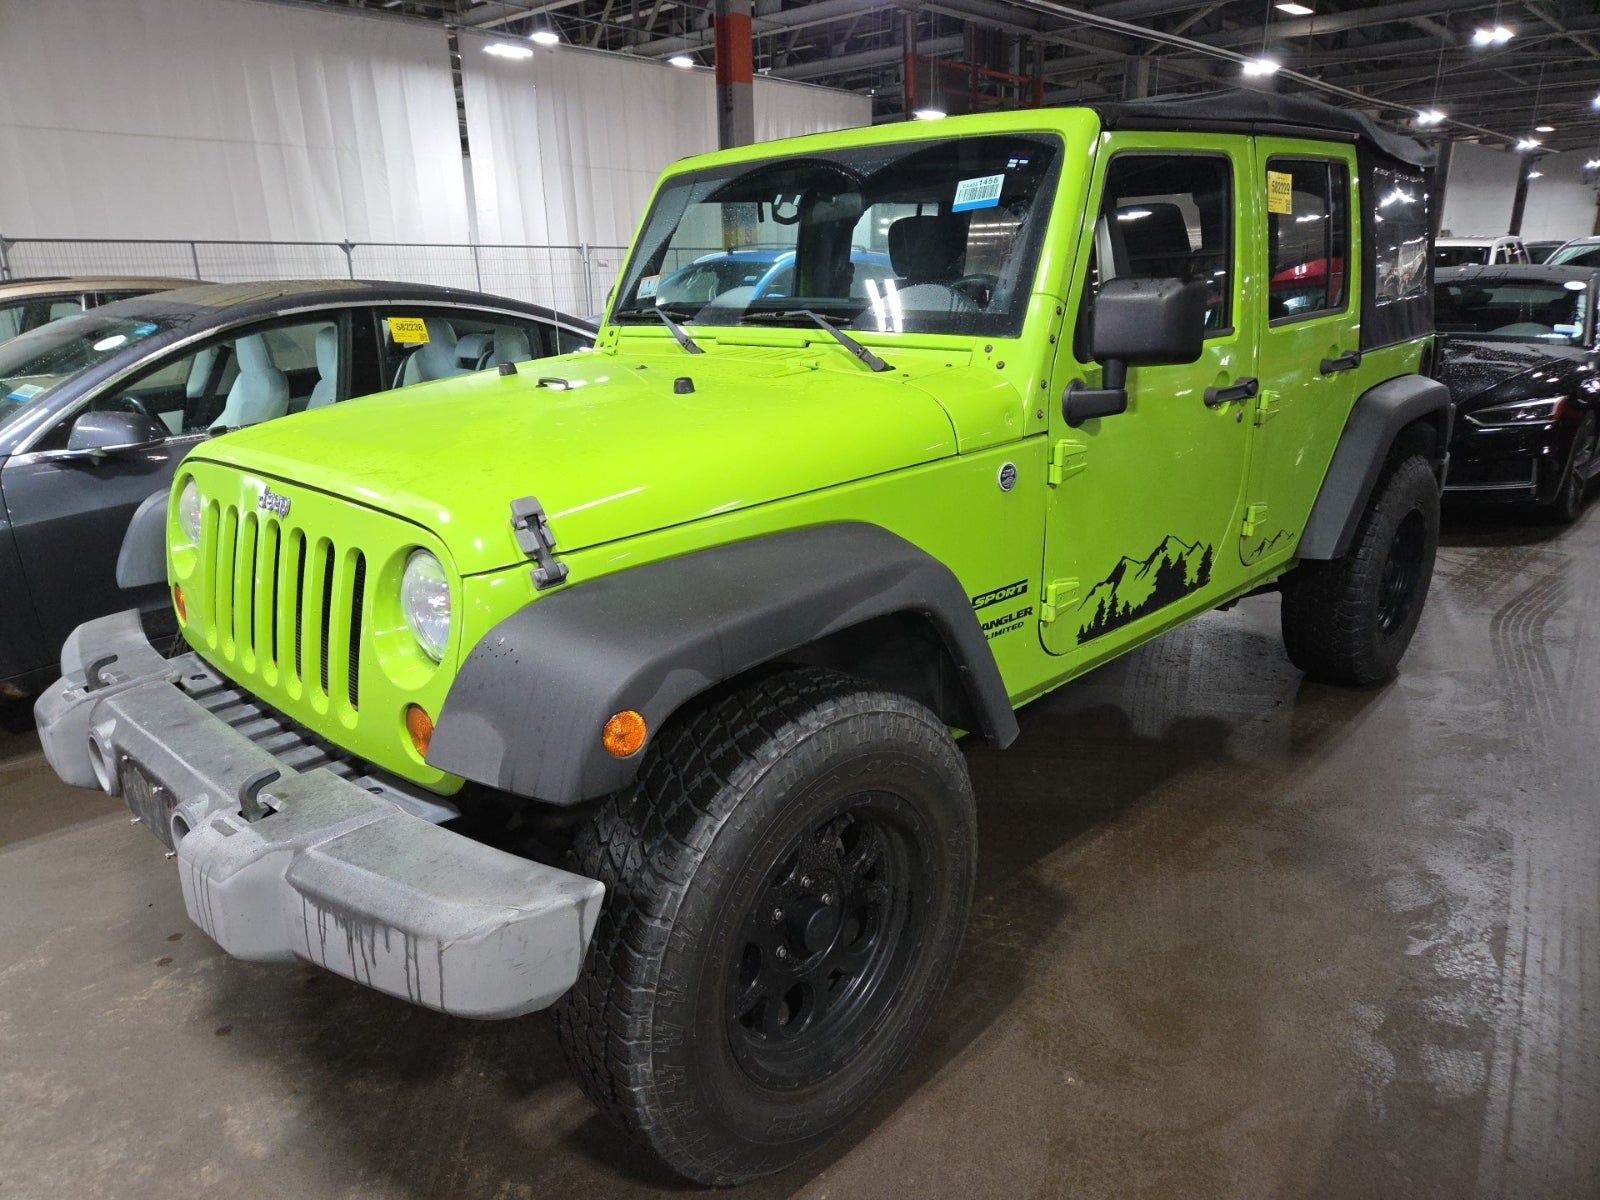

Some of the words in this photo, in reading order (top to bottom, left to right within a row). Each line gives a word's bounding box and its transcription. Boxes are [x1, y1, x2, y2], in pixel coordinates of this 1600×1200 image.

[973, 584, 1024, 608] SPORT
[982, 606, 1033, 631] ANGLER
[985, 621, 1024, 640] LIMITED
